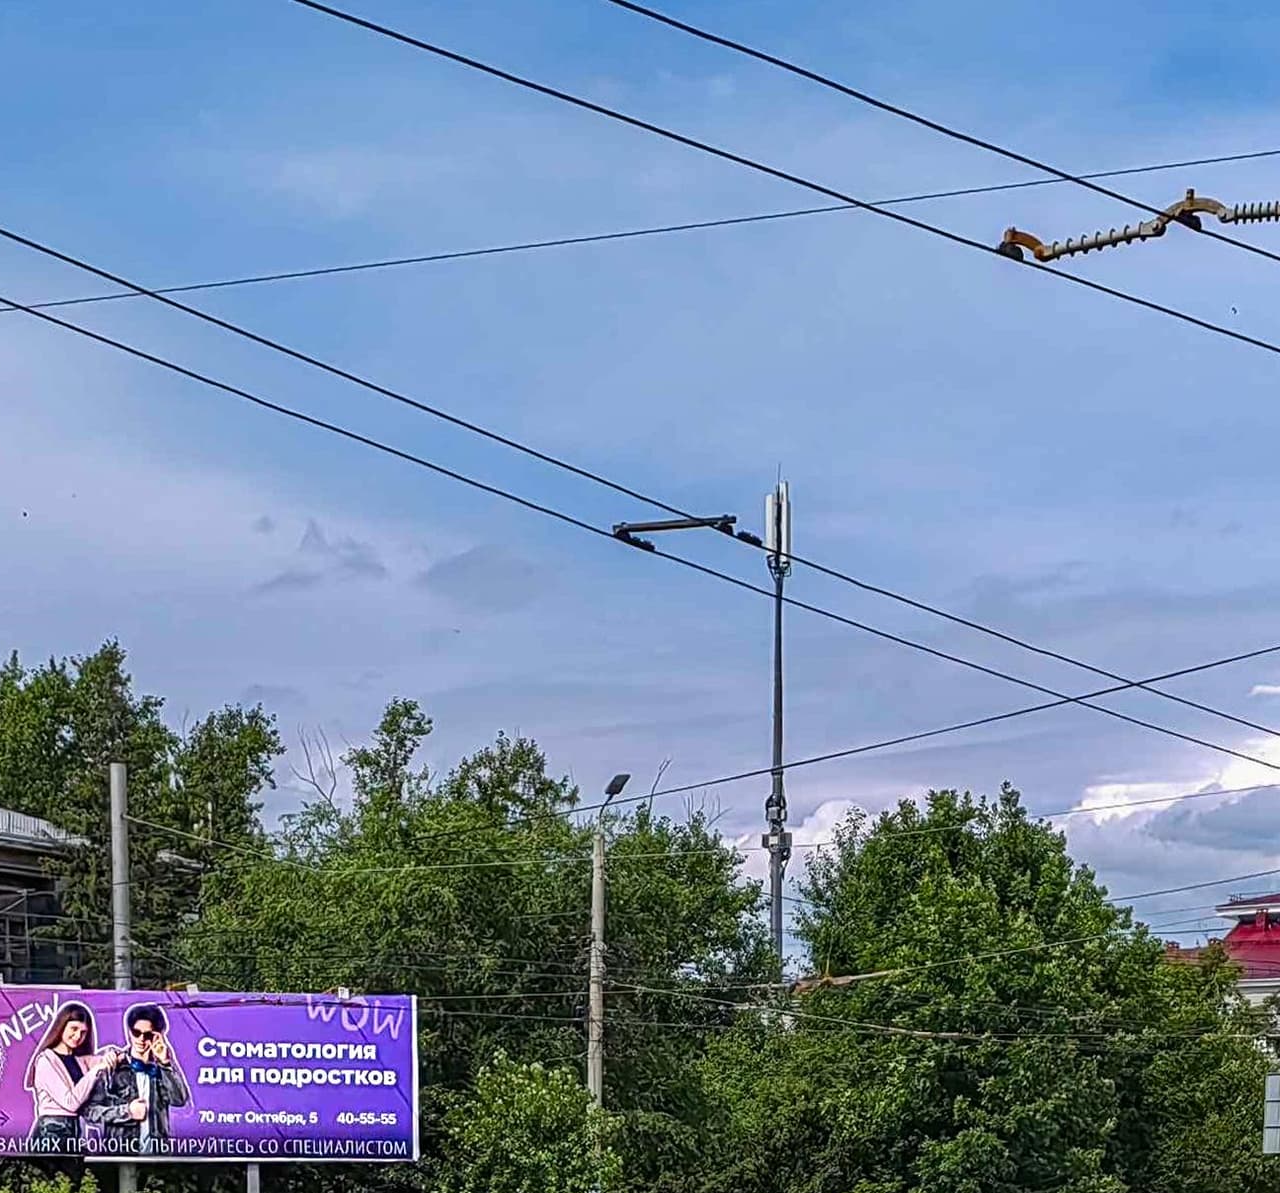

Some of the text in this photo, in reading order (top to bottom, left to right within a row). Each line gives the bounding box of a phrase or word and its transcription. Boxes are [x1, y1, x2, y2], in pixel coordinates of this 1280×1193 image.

[0, 992, 59, 1047] NEW
[306, 994, 405, 1040] WOW
[197, 1036, 377, 1060] Стоматология
[197, 1066, 397, 1088] для подростков
[198, 1110, 319, 1126] 70 лет Октября, 5
[336, 1112, 398, 1125] 40-55-55
[66, 1134, 254, 1154] ПРОКОНСУЛЬТИРУЙТЕСЬ
[259, 1138, 279, 1154] СО
[283, 1138, 407, 1157] СПЕЦИАЛИСТОМ
